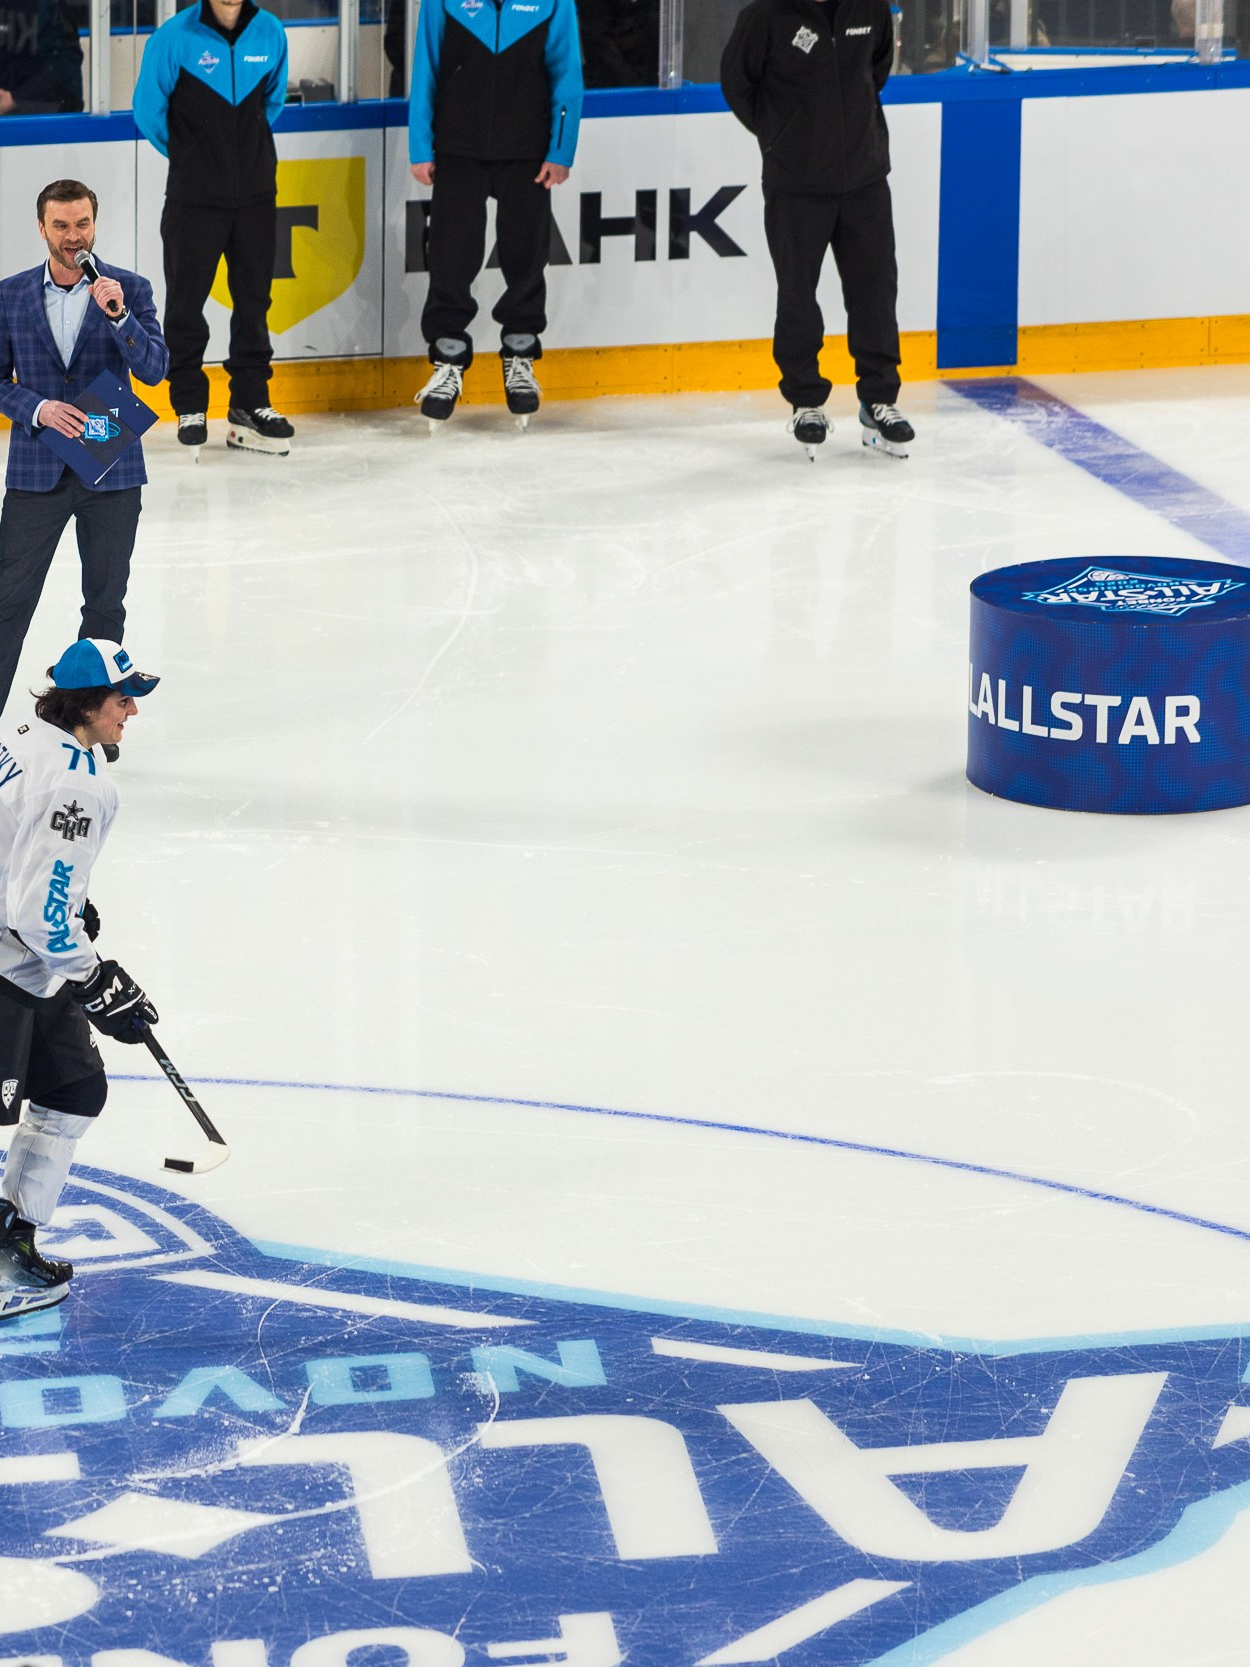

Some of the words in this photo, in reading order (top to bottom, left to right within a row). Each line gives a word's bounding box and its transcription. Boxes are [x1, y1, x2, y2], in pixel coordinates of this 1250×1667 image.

[405, 185, 748, 273] НК
[61, 742, 96, 776] 71
[81, 975, 124, 1012] CM
